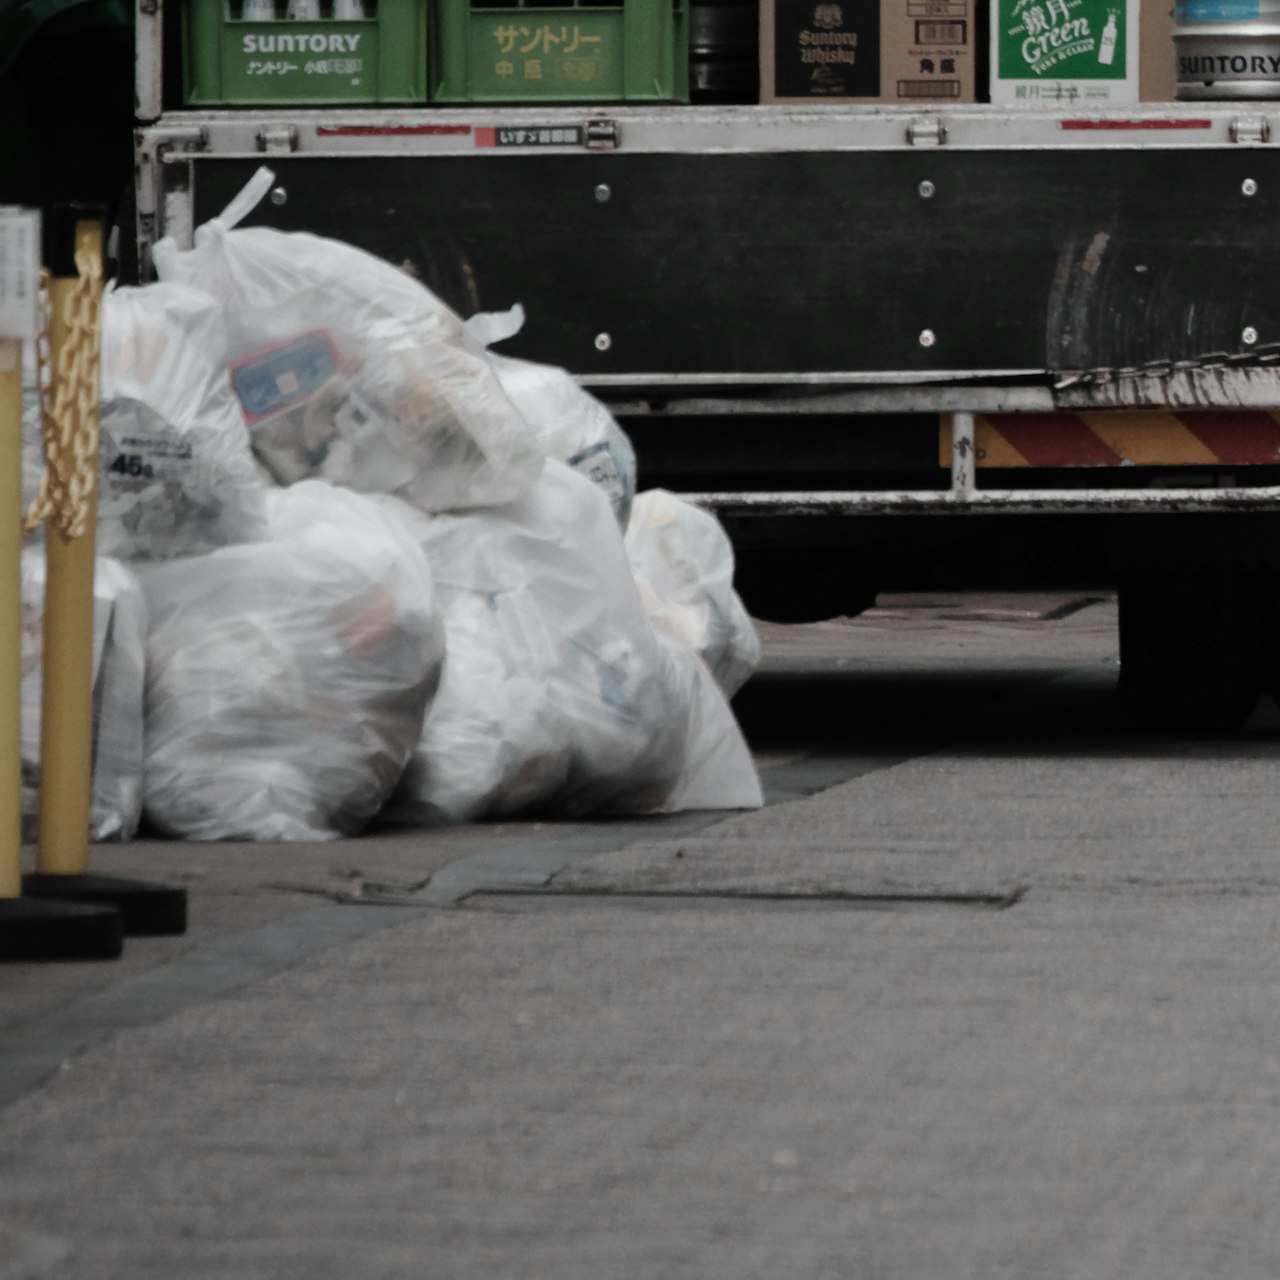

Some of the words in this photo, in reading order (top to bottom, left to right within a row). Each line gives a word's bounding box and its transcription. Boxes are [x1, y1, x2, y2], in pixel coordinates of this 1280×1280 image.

[493, 25, 601, 54] サントリー
[799, 30, 857, 48] Suntory
[1022, 17, 1091, 64] Green
[801, 47, 856, 65] Whisky
